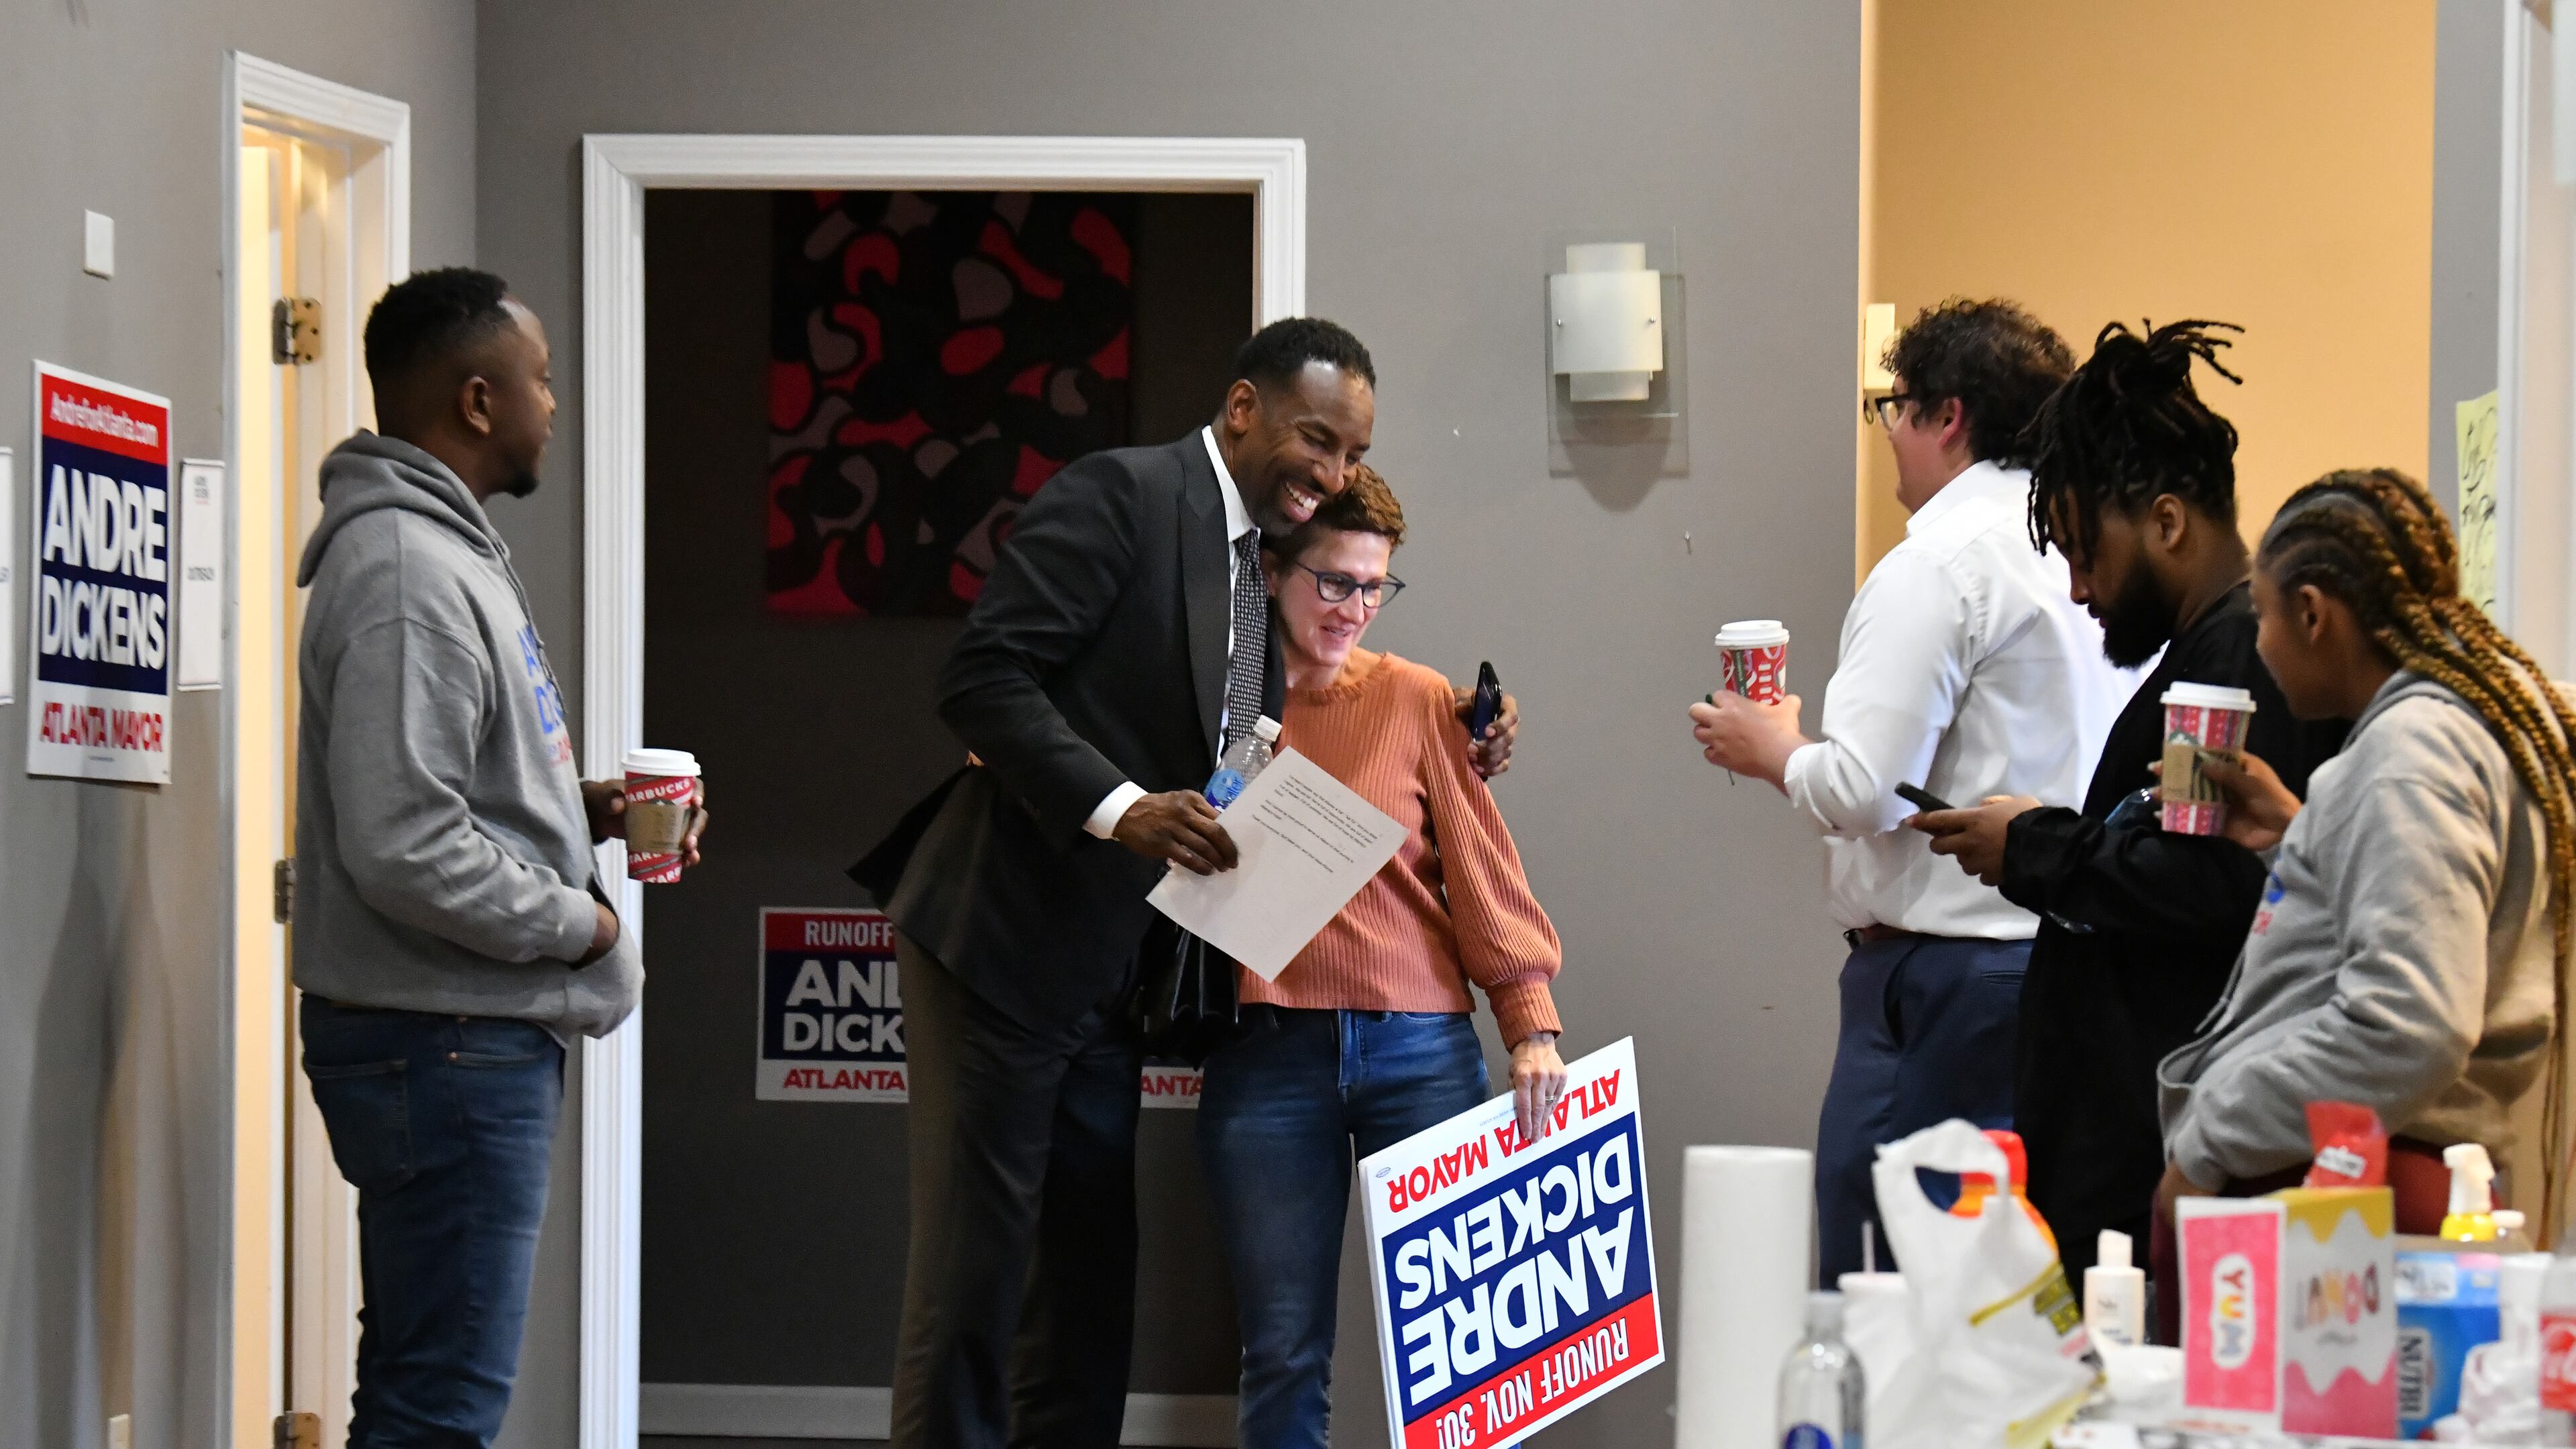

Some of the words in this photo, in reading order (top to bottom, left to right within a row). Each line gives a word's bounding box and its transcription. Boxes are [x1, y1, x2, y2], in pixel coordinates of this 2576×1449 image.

[43, 464, 166, 582] ANDRE
[41, 576, 166, 671] DICKENS
[40, 701, 107, 749] ATLANTA
[111, 708, 163, 753] MAYOR
[805, 920, 894, 947] RUNOFF
[783, 1012, 906, 1053] DICK
[784, 1068, 906, 1091] ATLANTA
[1493, 1069, 1621, 1157] ATLATA
[1387, 1142, 1489, 1214] MAYOR
[1394, 1132, 1633, 1311] DICKENS
[1401, 1205, 1635, 1406] ANDRE
[2220, 1269, 2247, 1358] YUM
[1540, 1317, 1630, 1405] RUNOFF
[1436, 1402, 1476, 1449] 30!
[1480, 1368, 1534, 1436] NOV.
